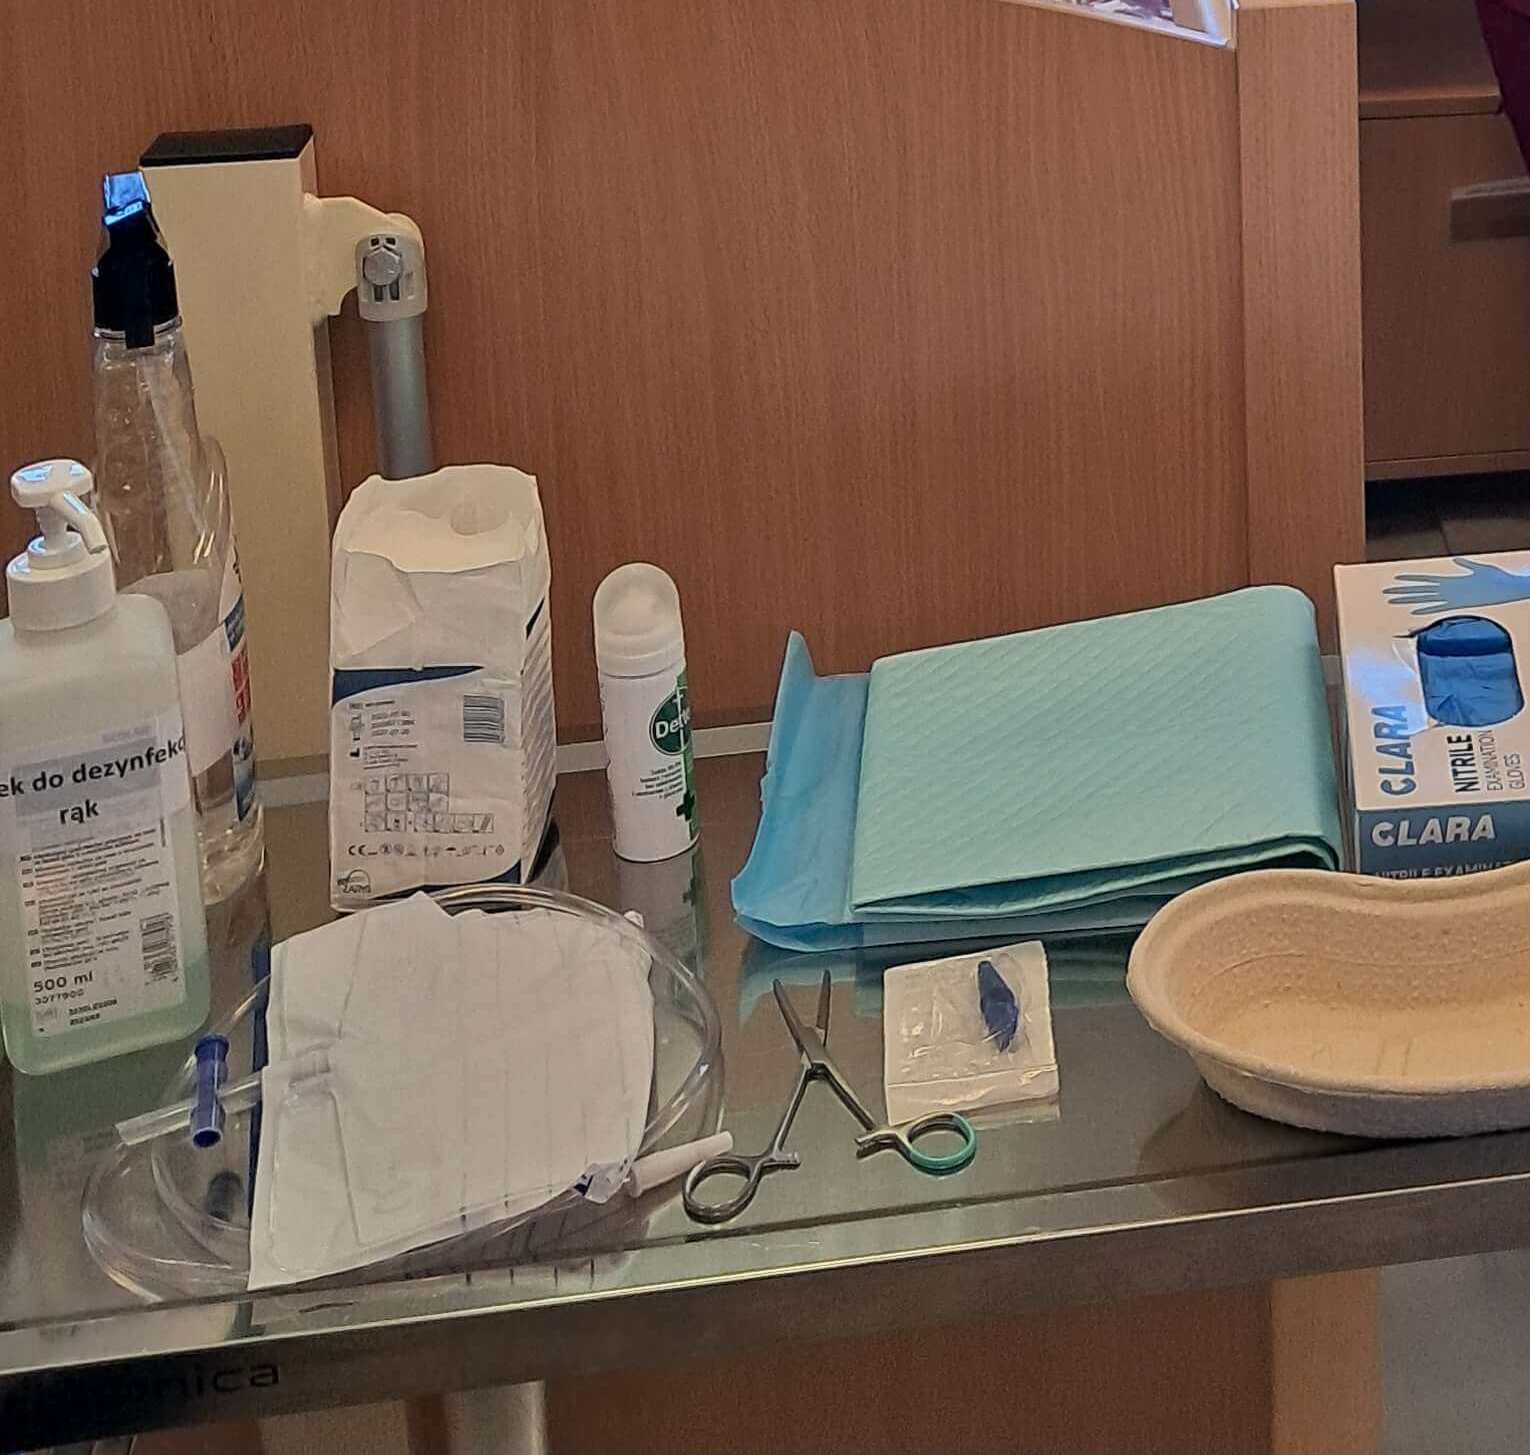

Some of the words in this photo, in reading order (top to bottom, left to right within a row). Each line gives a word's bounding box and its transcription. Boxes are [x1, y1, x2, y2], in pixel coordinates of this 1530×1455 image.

[1371, 706, 1417, 795] CLARA
[1446, 734, 1481, 792] NITRILE
[1478, 729, 1504, 791] EXAMINATION
[32, 770, 64, 792] do
[1503, 753, 1526, 789] GLOVES
[59, 799, 99, 825] rąk
[1371, 814, 1496, 846] CLARA
[33, 976, 67, 993] 500
[74, 971, 93, 986] ml
